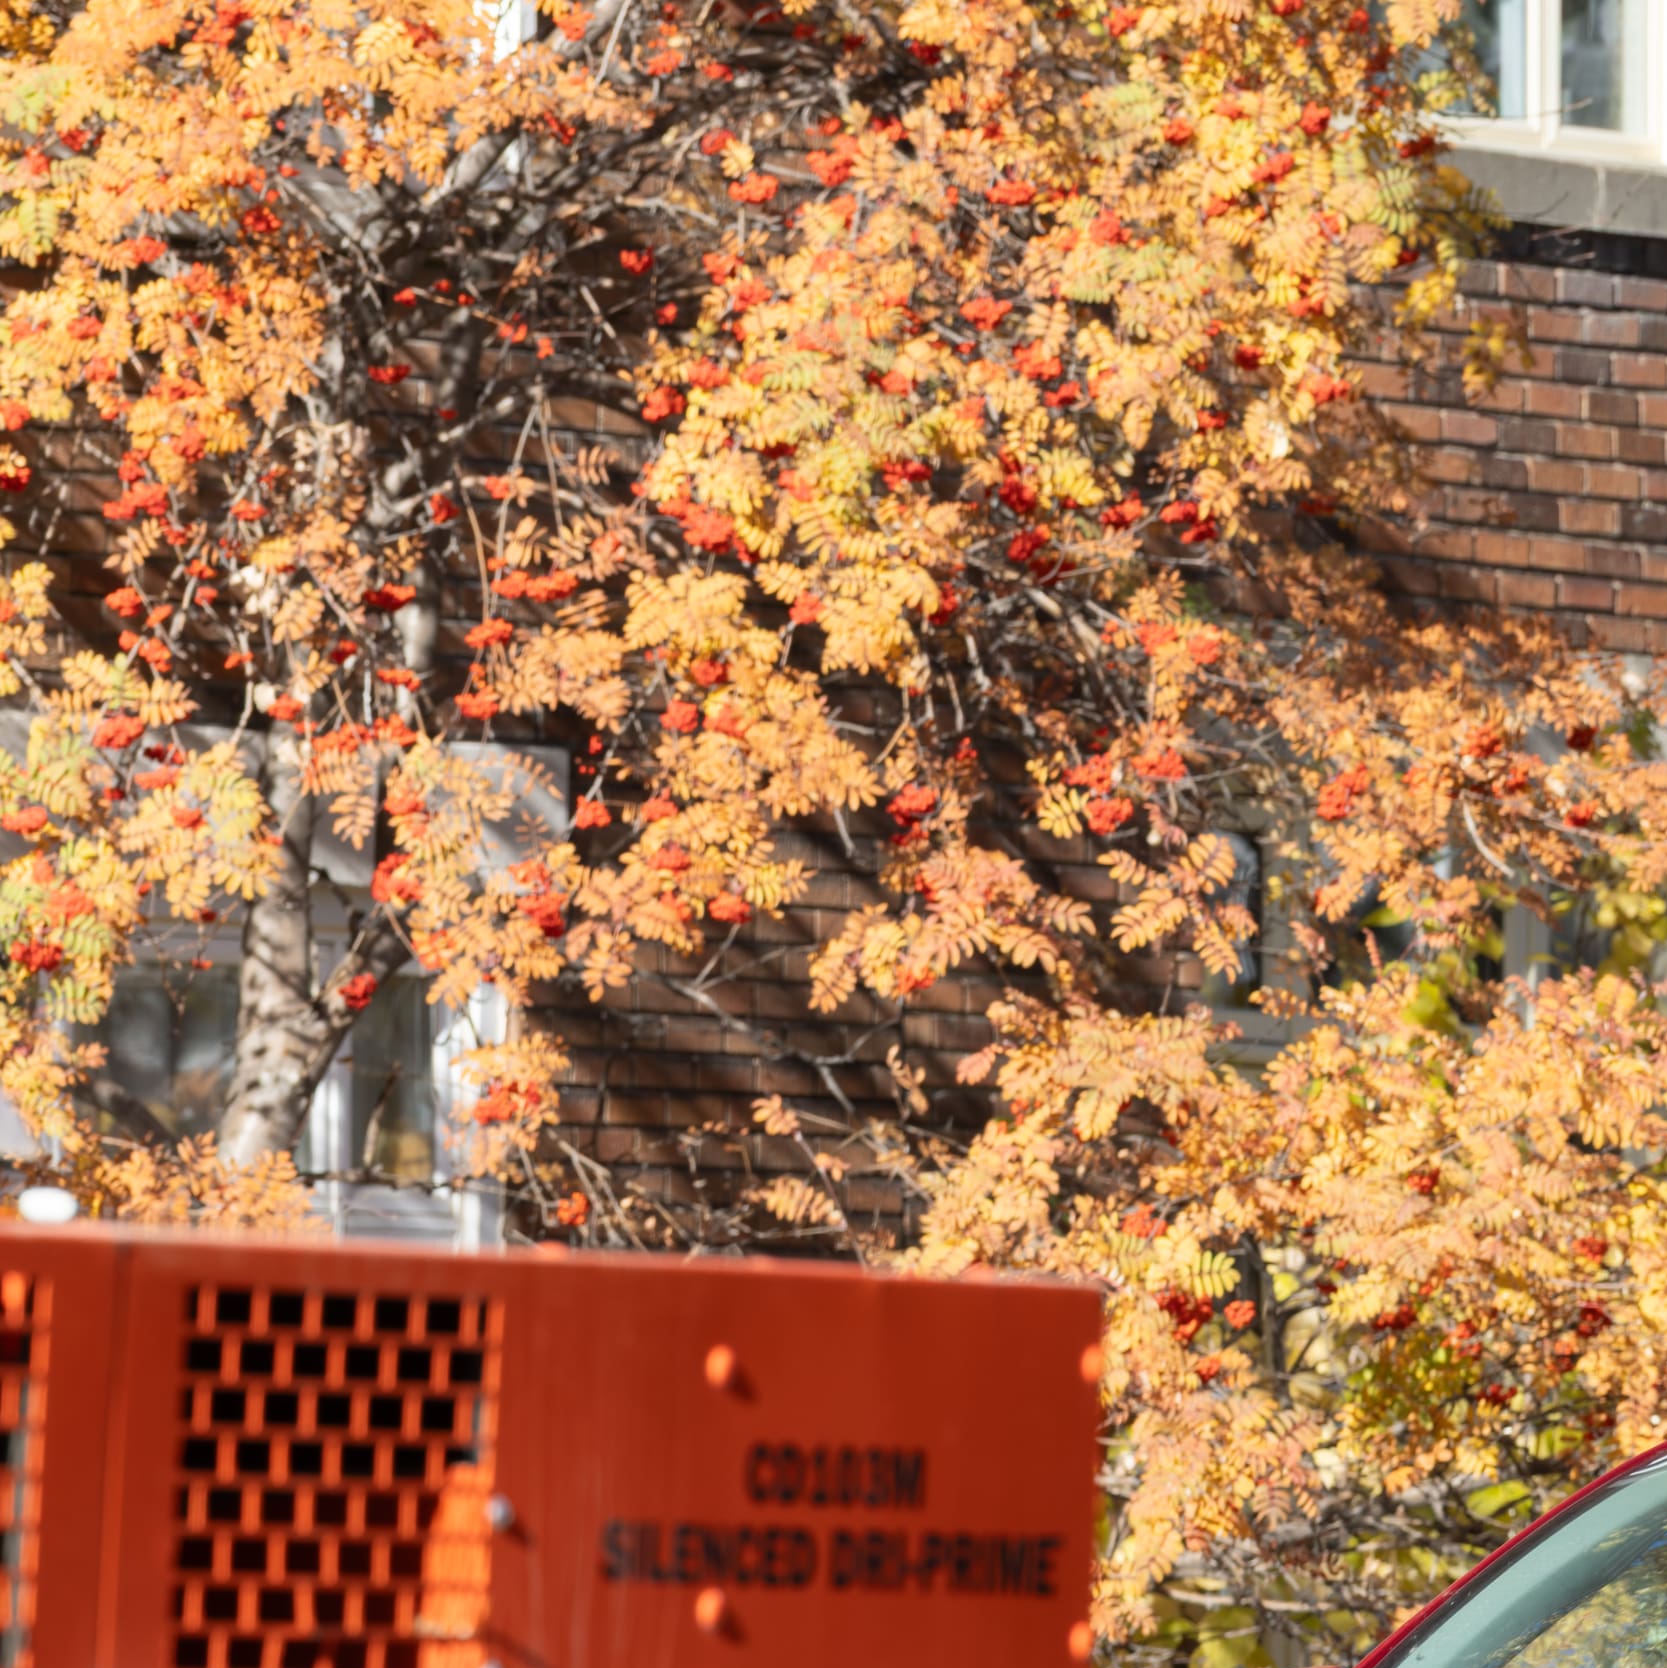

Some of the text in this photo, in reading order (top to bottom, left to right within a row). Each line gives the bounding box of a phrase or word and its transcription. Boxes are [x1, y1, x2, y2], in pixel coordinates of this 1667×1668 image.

[746, 1443, 926, 1508] CD103M
[601, 1522, 1064, 1596] SILENCED DRI-PRIME
